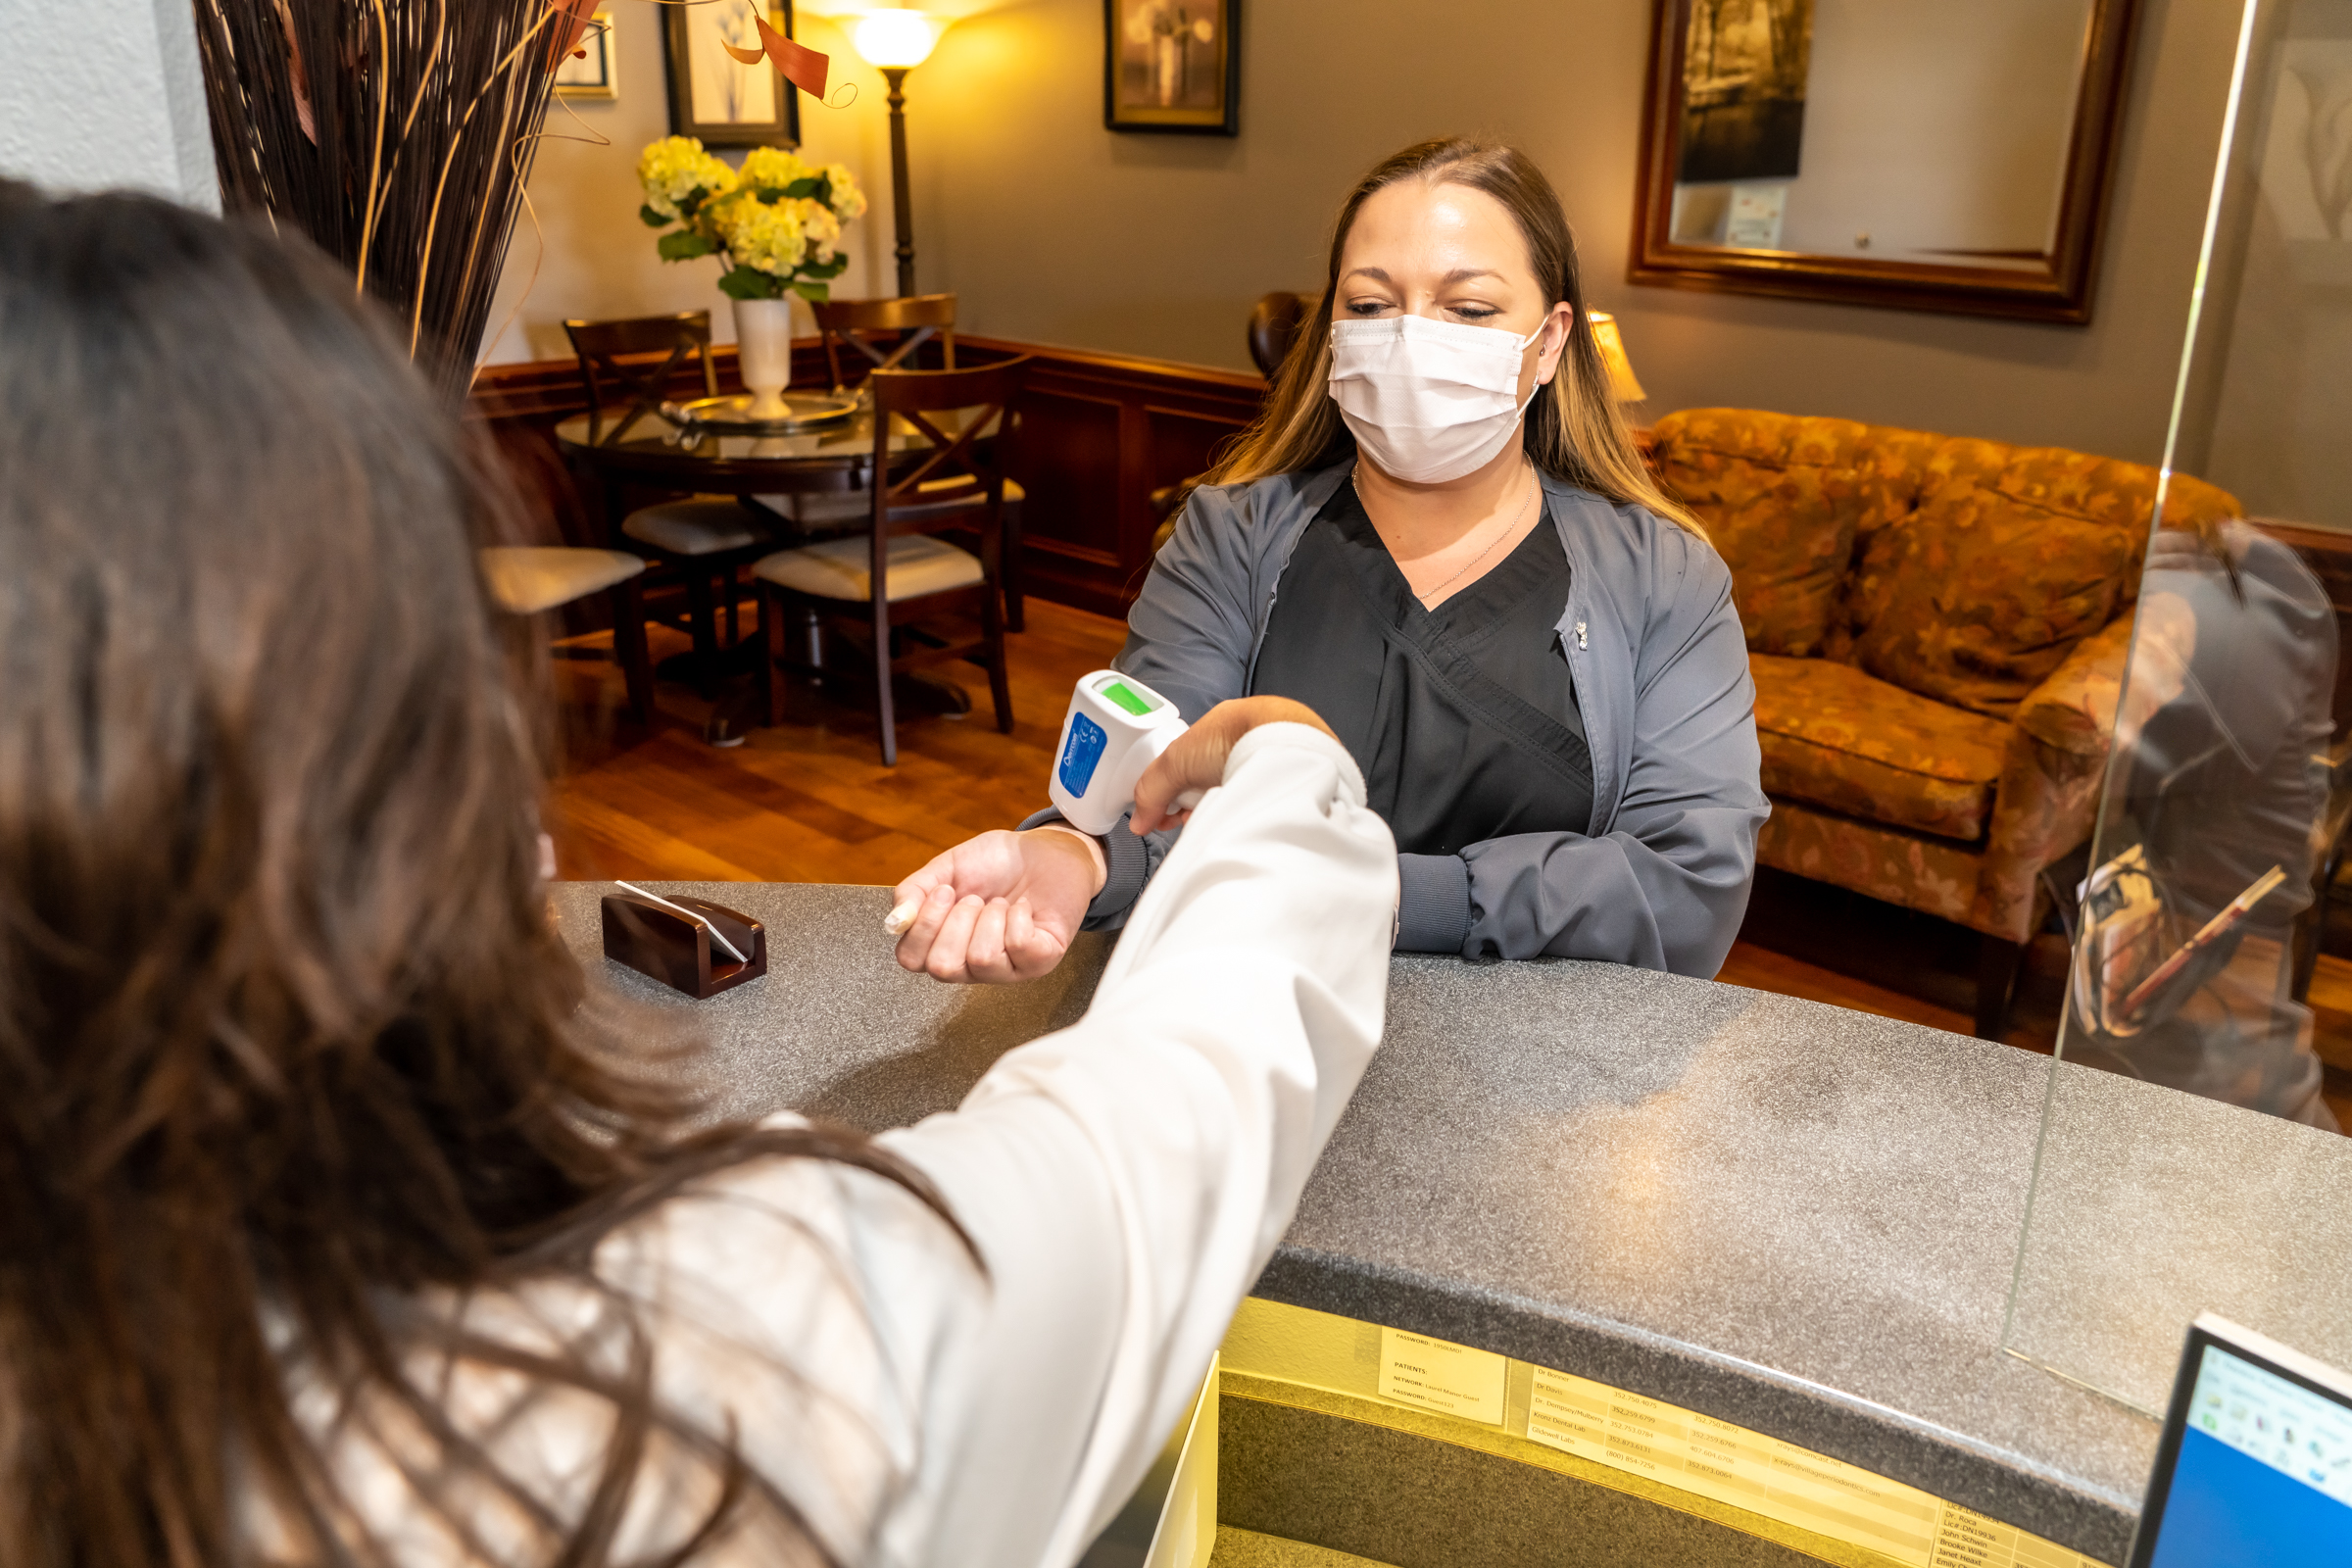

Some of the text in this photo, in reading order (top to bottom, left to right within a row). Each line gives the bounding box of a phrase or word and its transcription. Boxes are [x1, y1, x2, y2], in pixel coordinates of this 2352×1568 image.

[1396, 1333, 1431, 1347] PASSWORD:
[1394, 1361, 1428, 1375] PATIENTS:
[1547, 1371, 1570, 1383] Bonner
[1393, 1375, 1480, 1402] NETWORK: Laurel Manor Guest
[1393, 1388, 1427, 1401] PASSWORD:
[1545, 1385, 1563, 1396] Davis
[1613, 1391, 1657, 1409] 352.750.4075
[1535, 1396, 1604, 1424] Dr. Dempsey/Mulberry
[1533, 1411, 1586, 1433] Kronz Dental Lab
[1609, 1420, 1653, 1439] 352.753.0784
[1693, 1414, 1740, 1435] 352.750.8072
[1532, 1426, 1576, 1446] Glidewell Labs
[1607, 1435, 1651, 1453] 352.873.6131
[1605, 1449, 1655, 1471] (800) 854-7256
[1690, 1445, 1735, 1465] 407.604.6706
[1776, 1442, 1842, 1469] xrays@comcast.net
[1773, 1457, 1881, 1498] x-rays@villageperiodontics.com
[1945, 1511, 1977, 1527] Dr. Roca
[1939, 1538, 1988, 1558] Brooke Wilke
[1940, 1529, 1987, 1548] John Schwin
[1936, 1557, 1957, 1568] Emily
[1937, 1547, 1958, 1559] Janet
